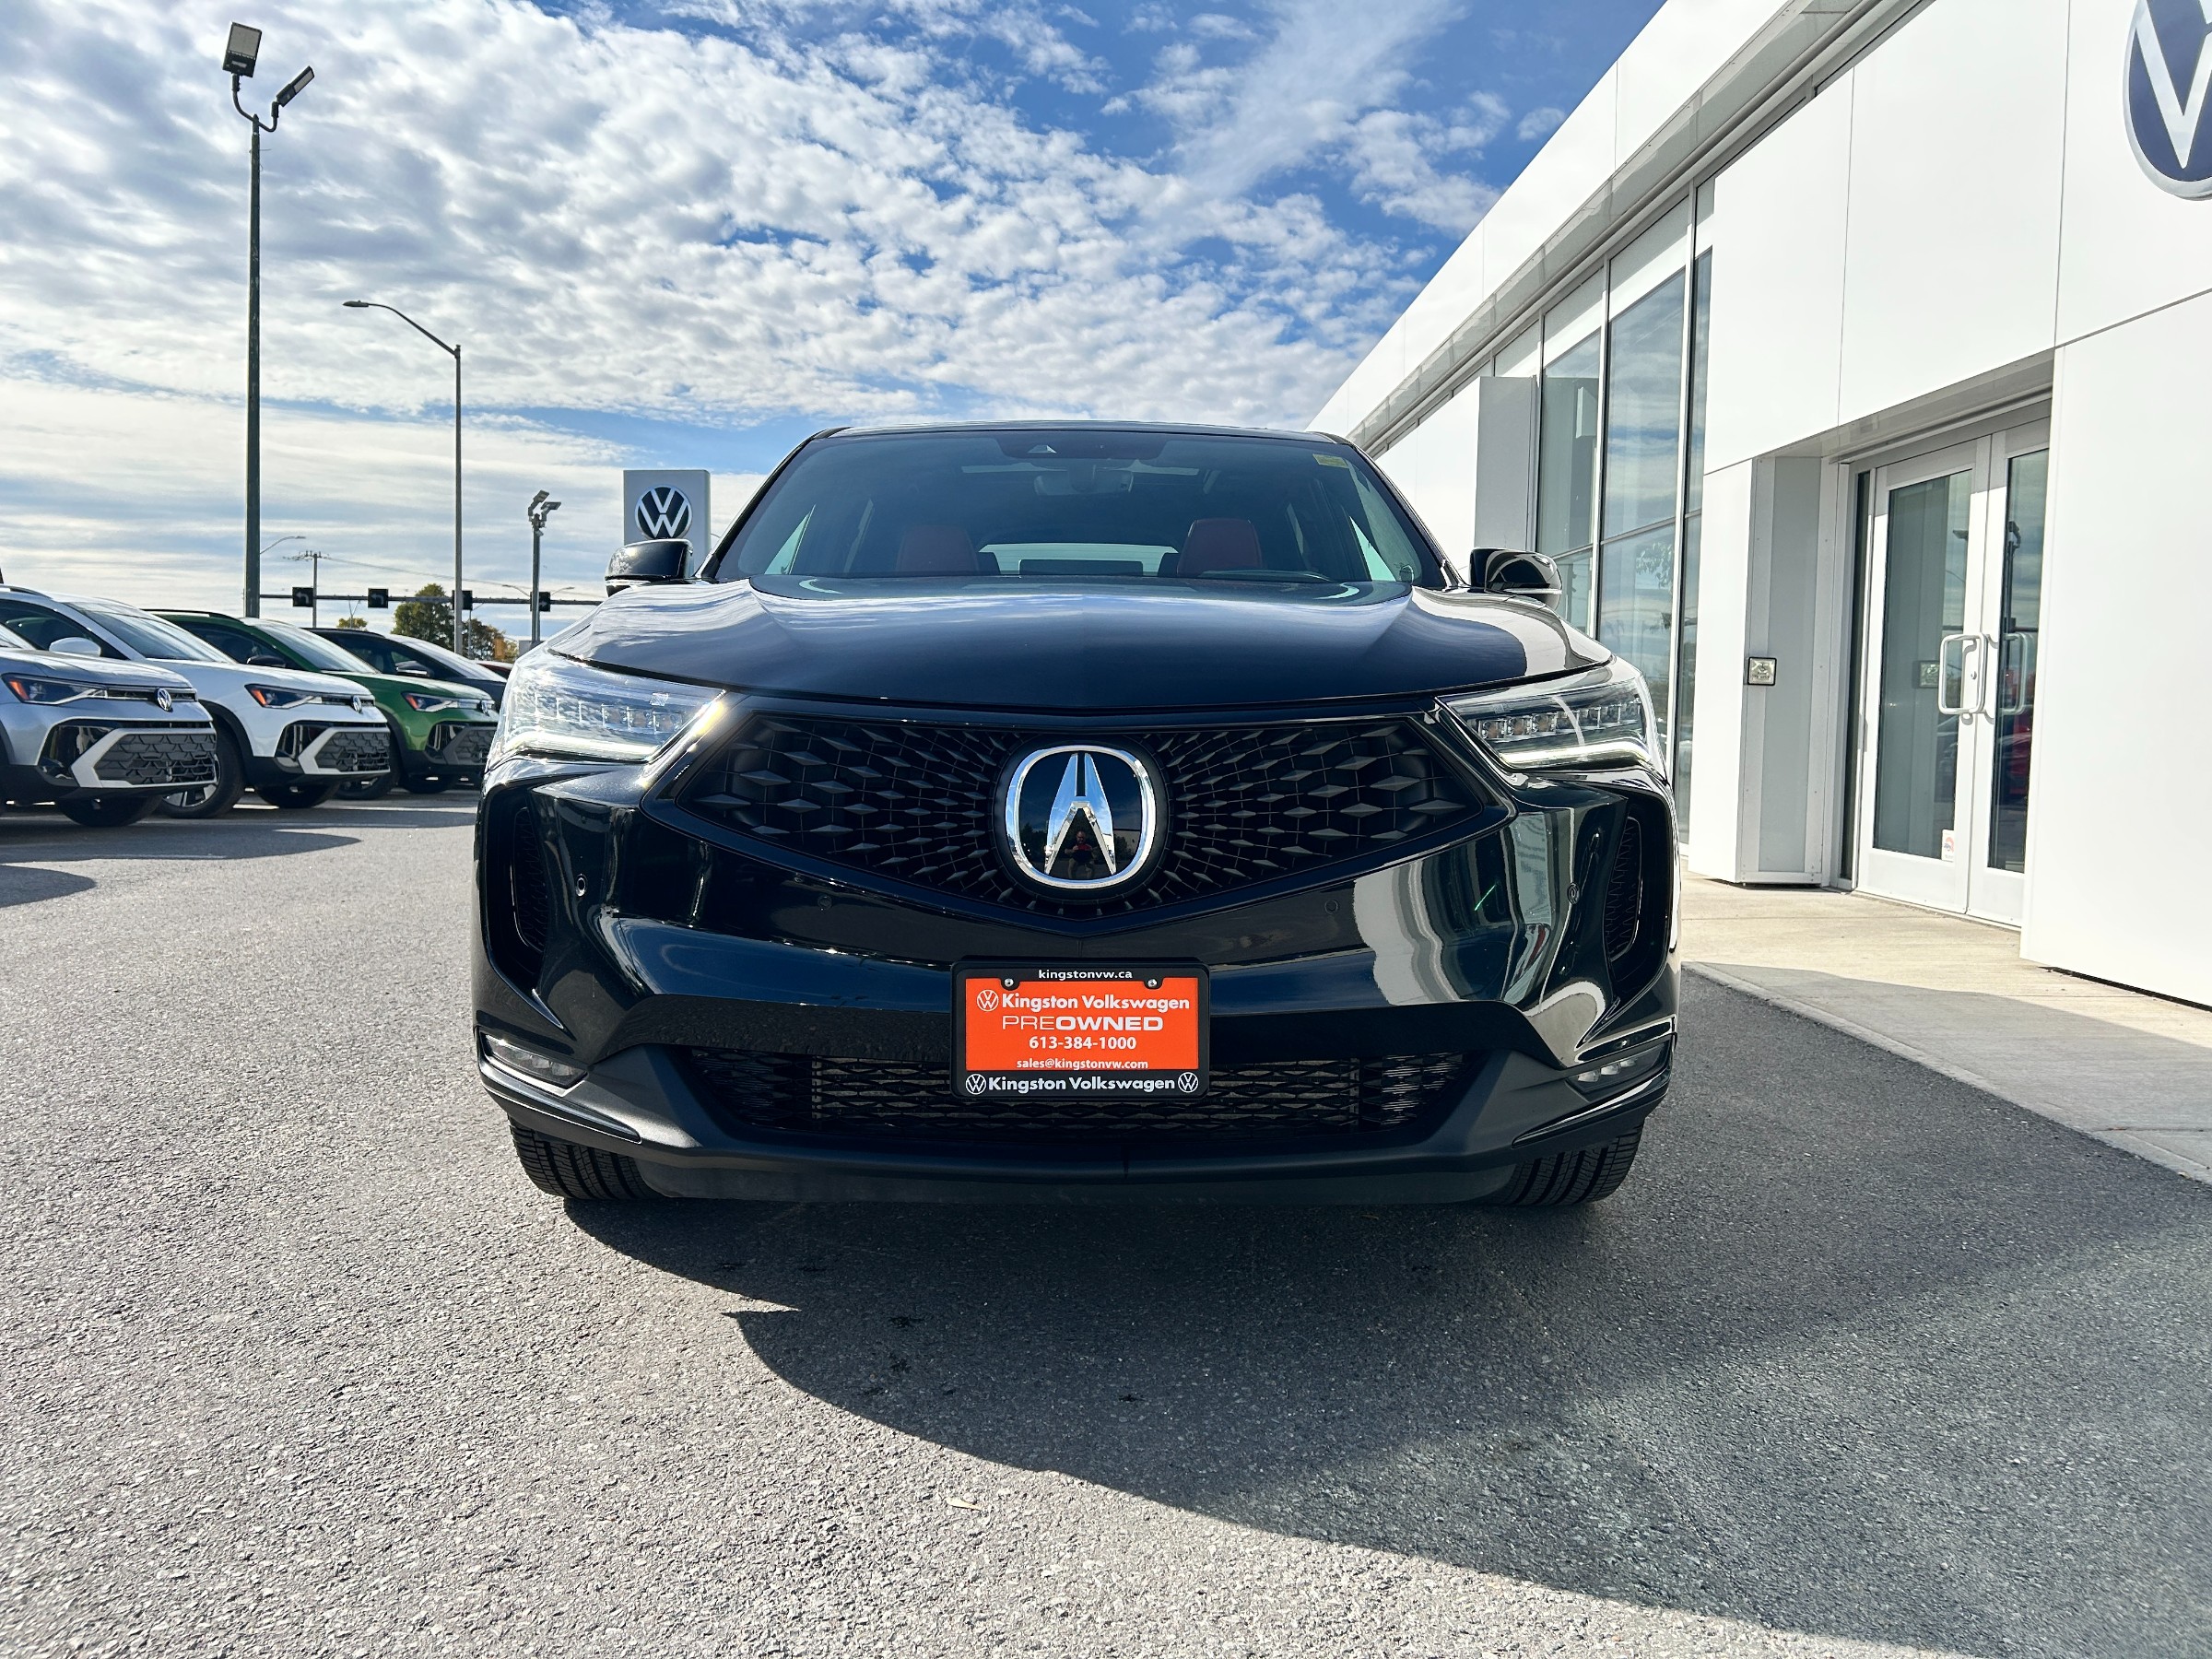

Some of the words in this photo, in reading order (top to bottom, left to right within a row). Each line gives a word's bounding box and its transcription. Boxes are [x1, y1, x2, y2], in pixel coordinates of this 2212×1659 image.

[635, 485, 693, 540] VW
[1039, 970, 1133, 981] kingstonvw.ca
[1002, 993, 1078, 1012] Kingston
[1082, 994, 1190, 1013] Volkswagen
[1002, 1016, 1164, 1031] PREOWNED
[1029, 1036, 1136, 1050] 613-384-1000
[1016, 1058, 1148, 1070] sales@kingstonvw.com
[988, 1077, 1066, 1094] Kingston
[1069, 1076, 1175, 1093] Volkswagen
